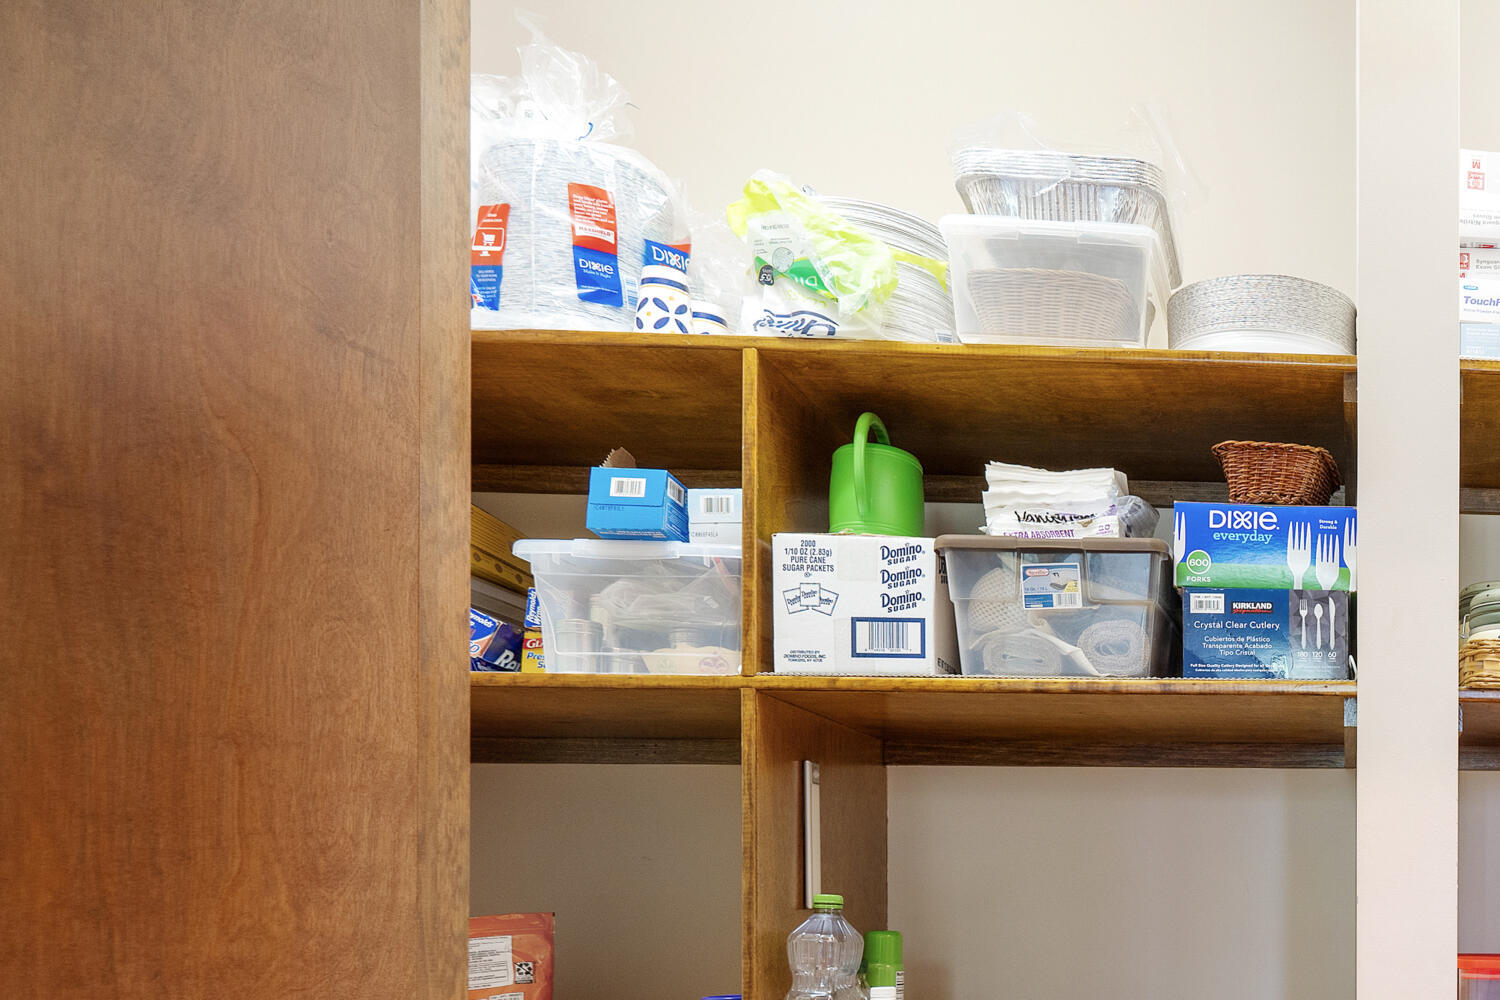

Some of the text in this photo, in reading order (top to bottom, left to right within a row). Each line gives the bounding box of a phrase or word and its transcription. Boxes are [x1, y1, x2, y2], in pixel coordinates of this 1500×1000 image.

[1031, 529, 1075, 539] ABSORBENT
[1213, 530, 1273, 544] everyday
[880, 543, 922, 560] Domino
[887, 555, 917, 565] SUGAR
[1189, 558, 1209, 567] 600
[880, 567, 922, 584] Domino
[887, 579, 917, 589] SUGAR
[880, 590, 922, 608] Domino
[887, 602, 917, 613] SUGAR
[1232, 602, 1273, 610] KIRKLAND
[1194, 621, 1280, 631] Crystal Clear Cutlery
